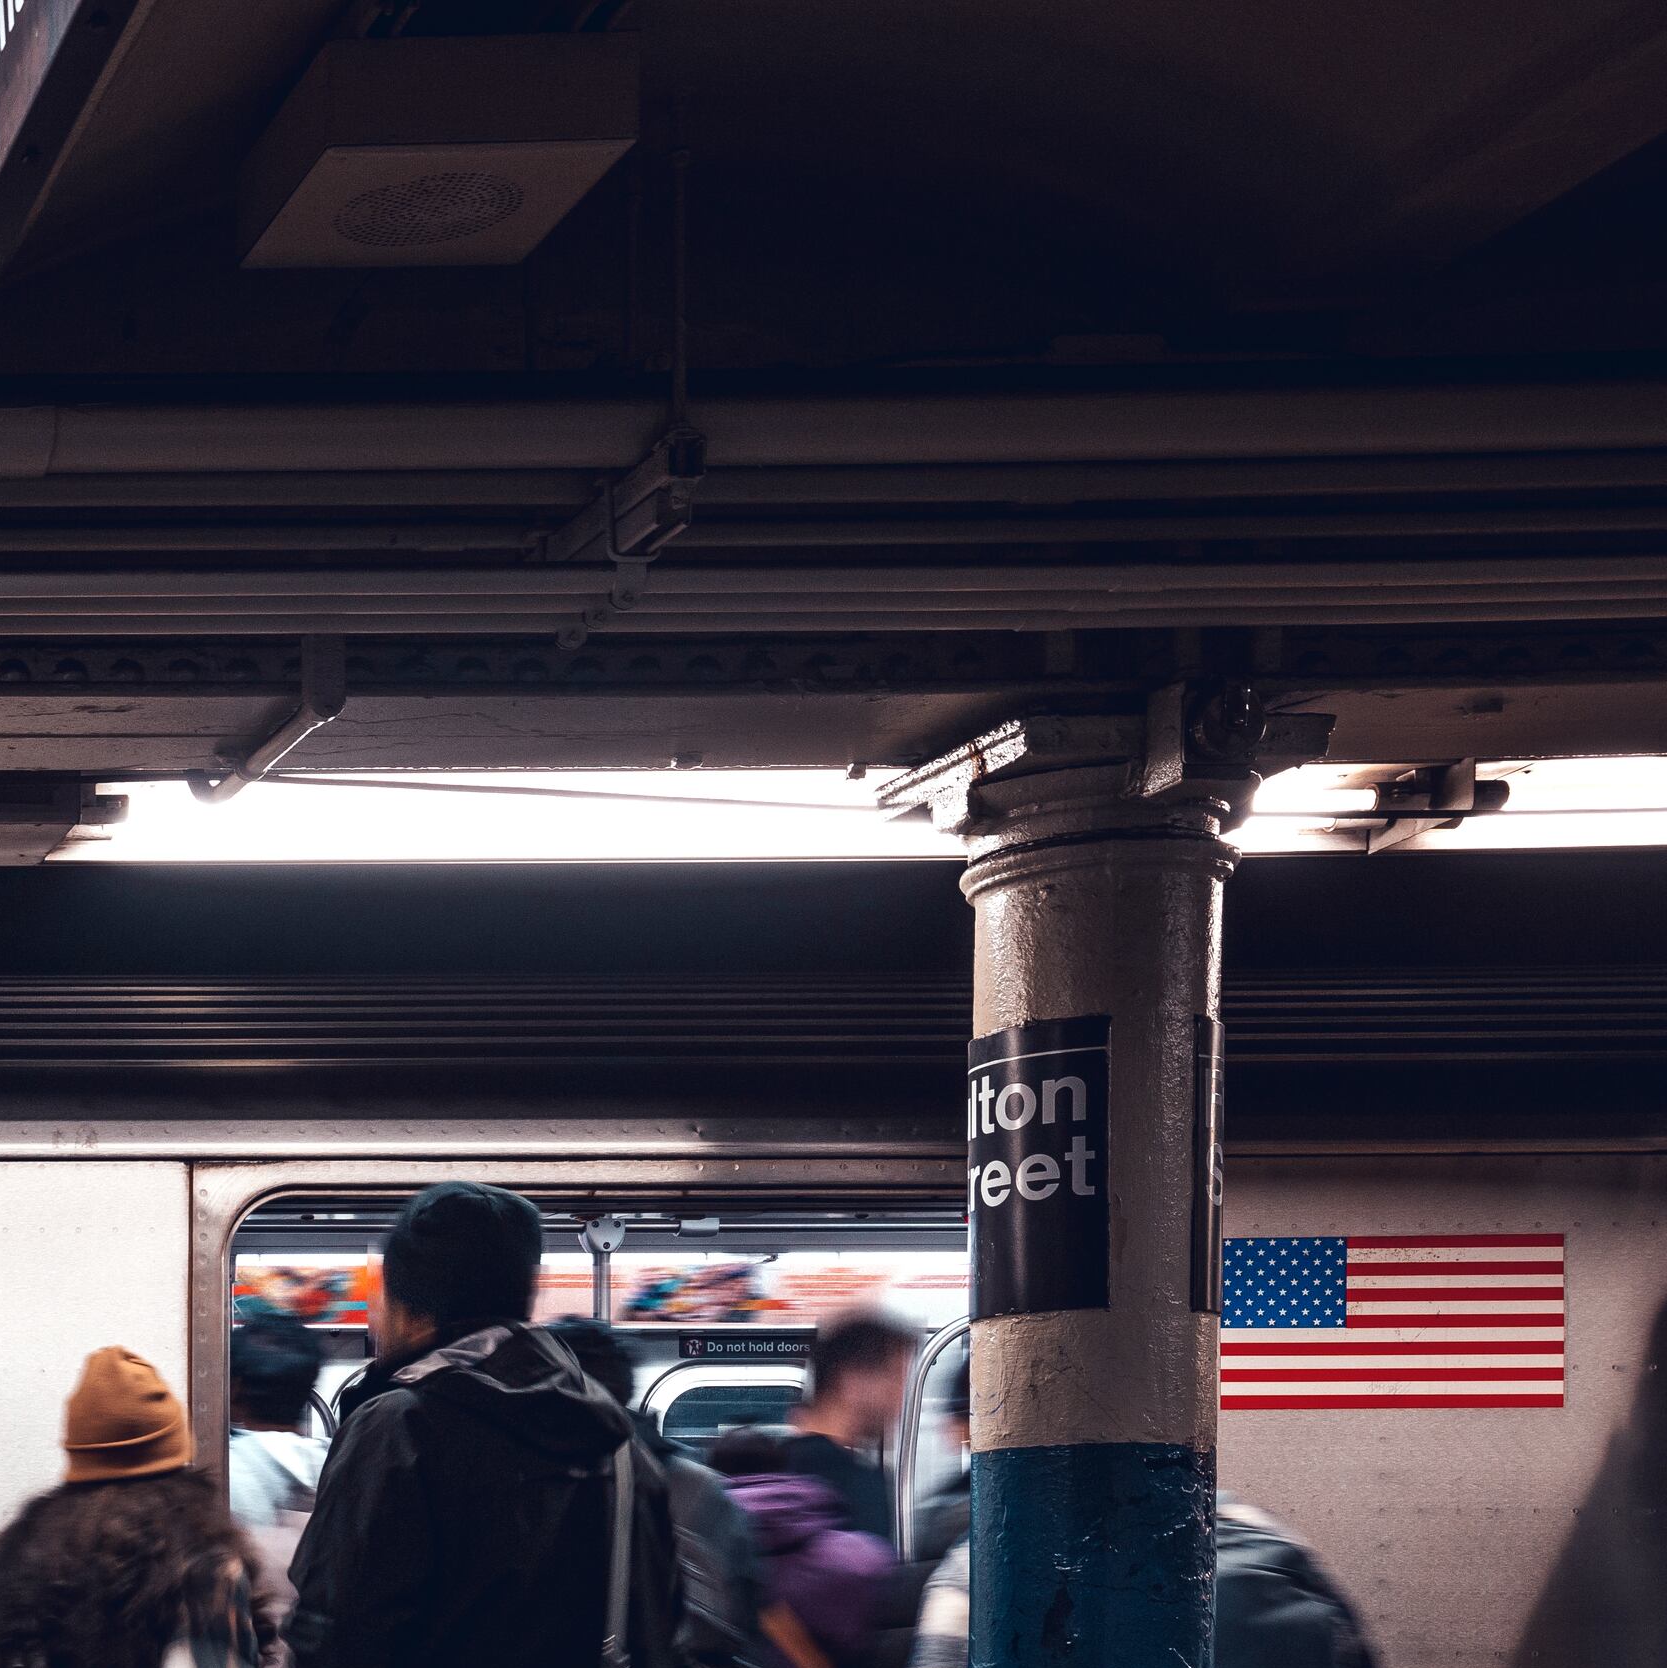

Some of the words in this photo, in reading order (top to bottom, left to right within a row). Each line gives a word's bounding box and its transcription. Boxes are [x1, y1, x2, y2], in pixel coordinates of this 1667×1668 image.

[968, 1075, 1087, 1141] lton
[968, 1136, 1095, 1213] reet
[707, 1341, 723, 1352] Do
[727, 1342, 745, 1352] not
[749, 1341, 774, 1352] hold
[777, 1341, 811, 1352] doors
